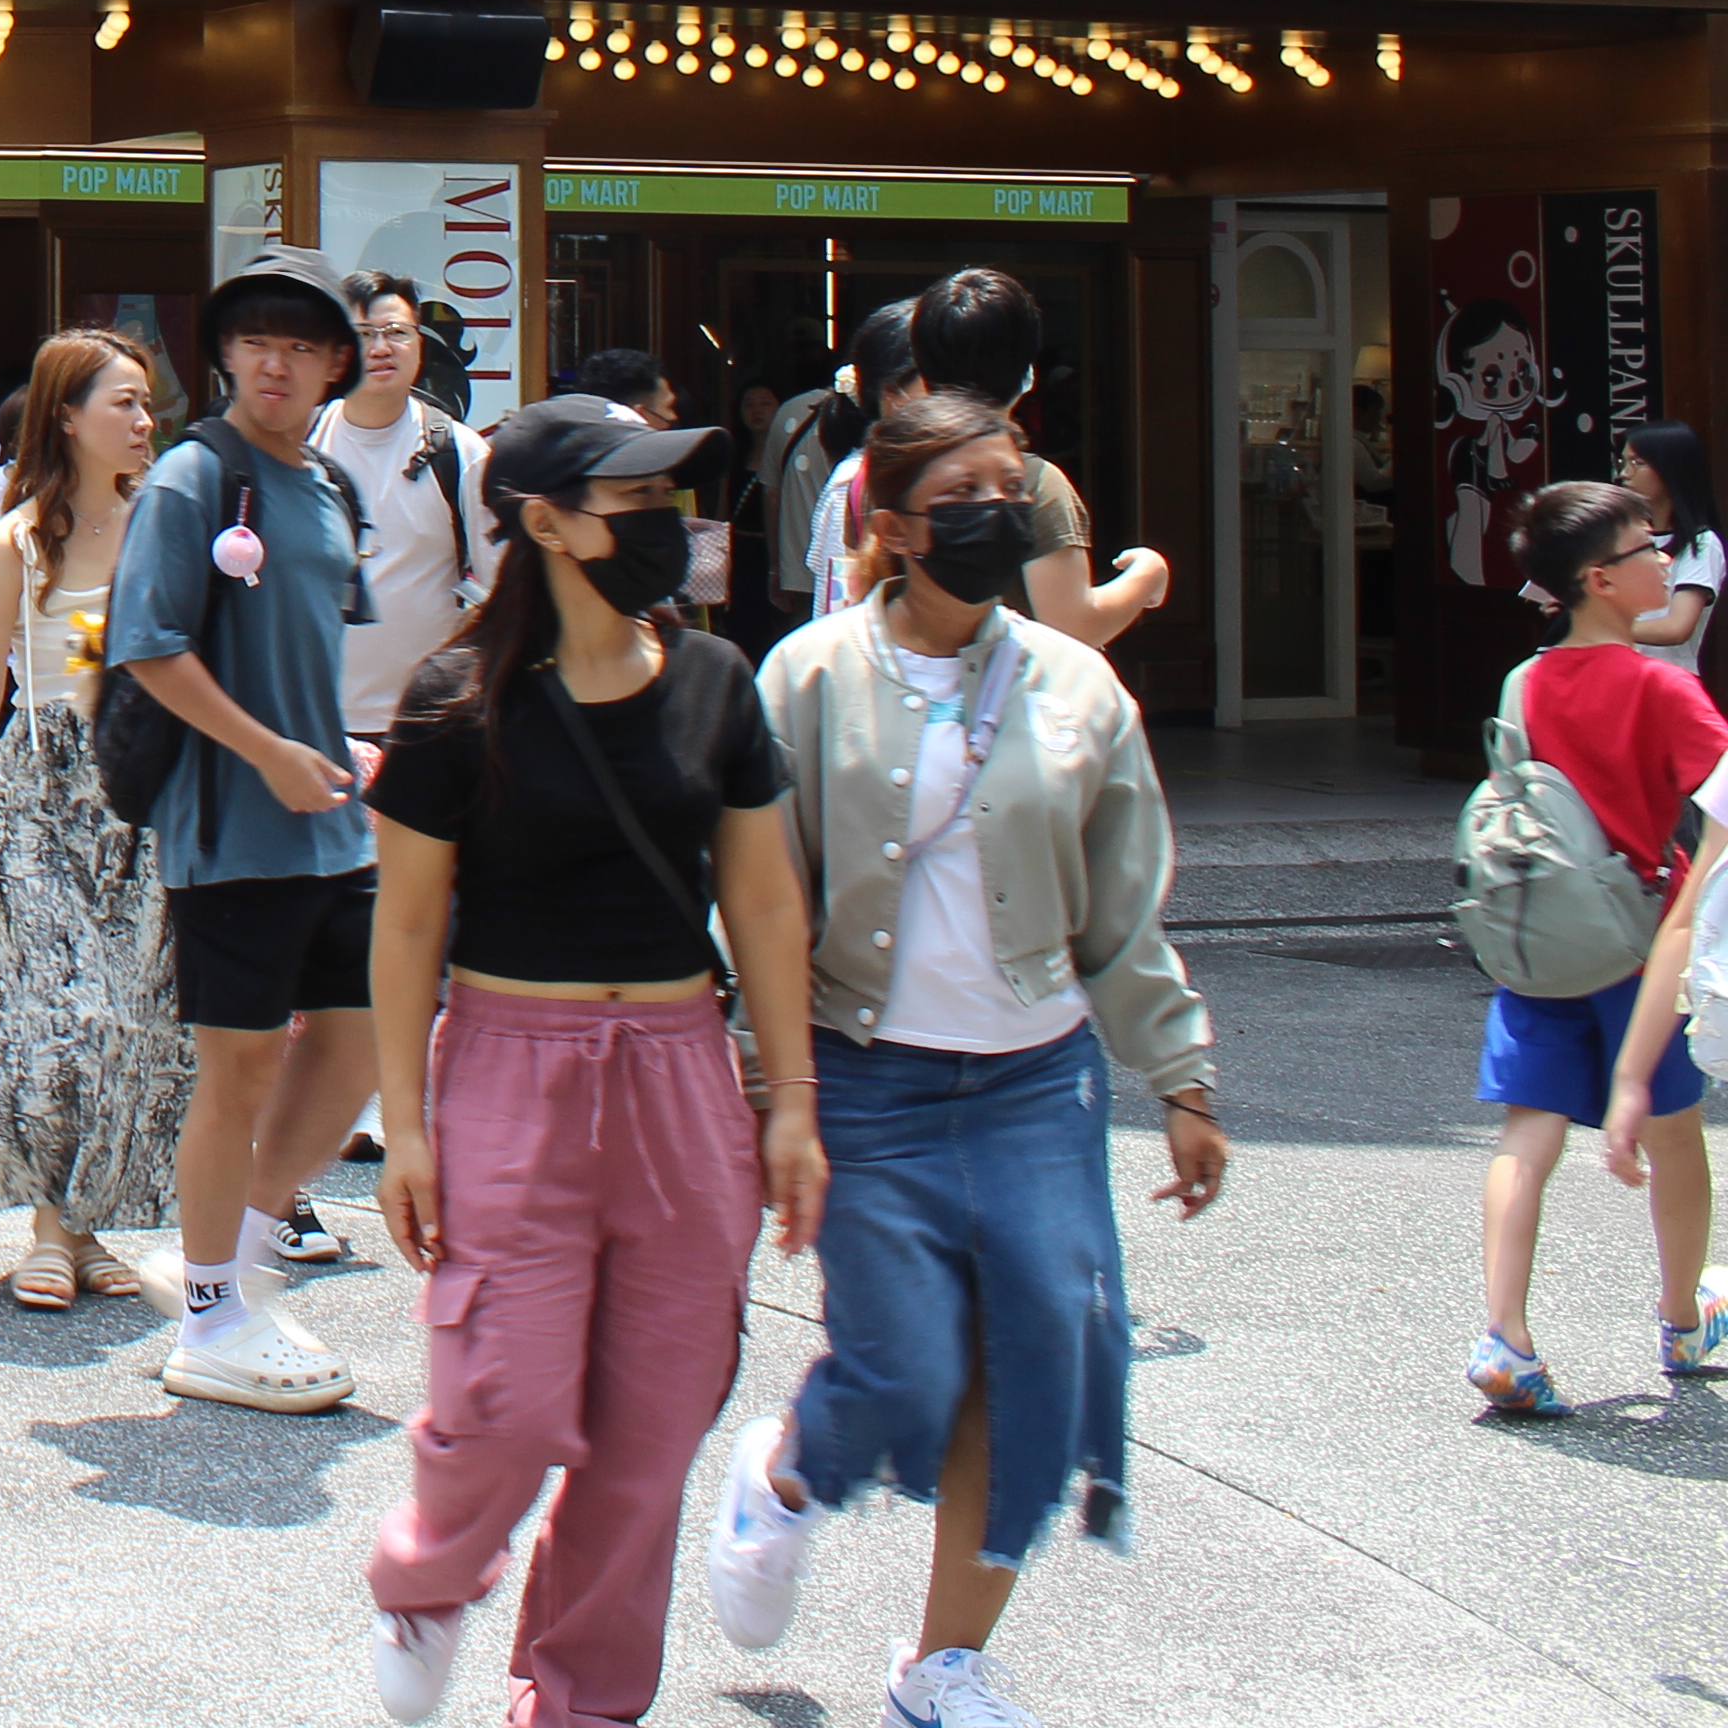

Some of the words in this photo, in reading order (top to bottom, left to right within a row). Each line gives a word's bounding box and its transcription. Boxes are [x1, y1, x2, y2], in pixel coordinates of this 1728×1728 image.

[62, 165, 108, 195] POP
[114, 165, 181, 195] MART
[545, 178, 574, 205] OP
[580, 179, 641, 207] MART
[775, 182, 816, 210] POP
[822, 182, 881, 211] MART
[993, 188, 1033, 215] POP
[1038, 188, 1095, 217] MART
[443, 171, 512, 436] MOLL
